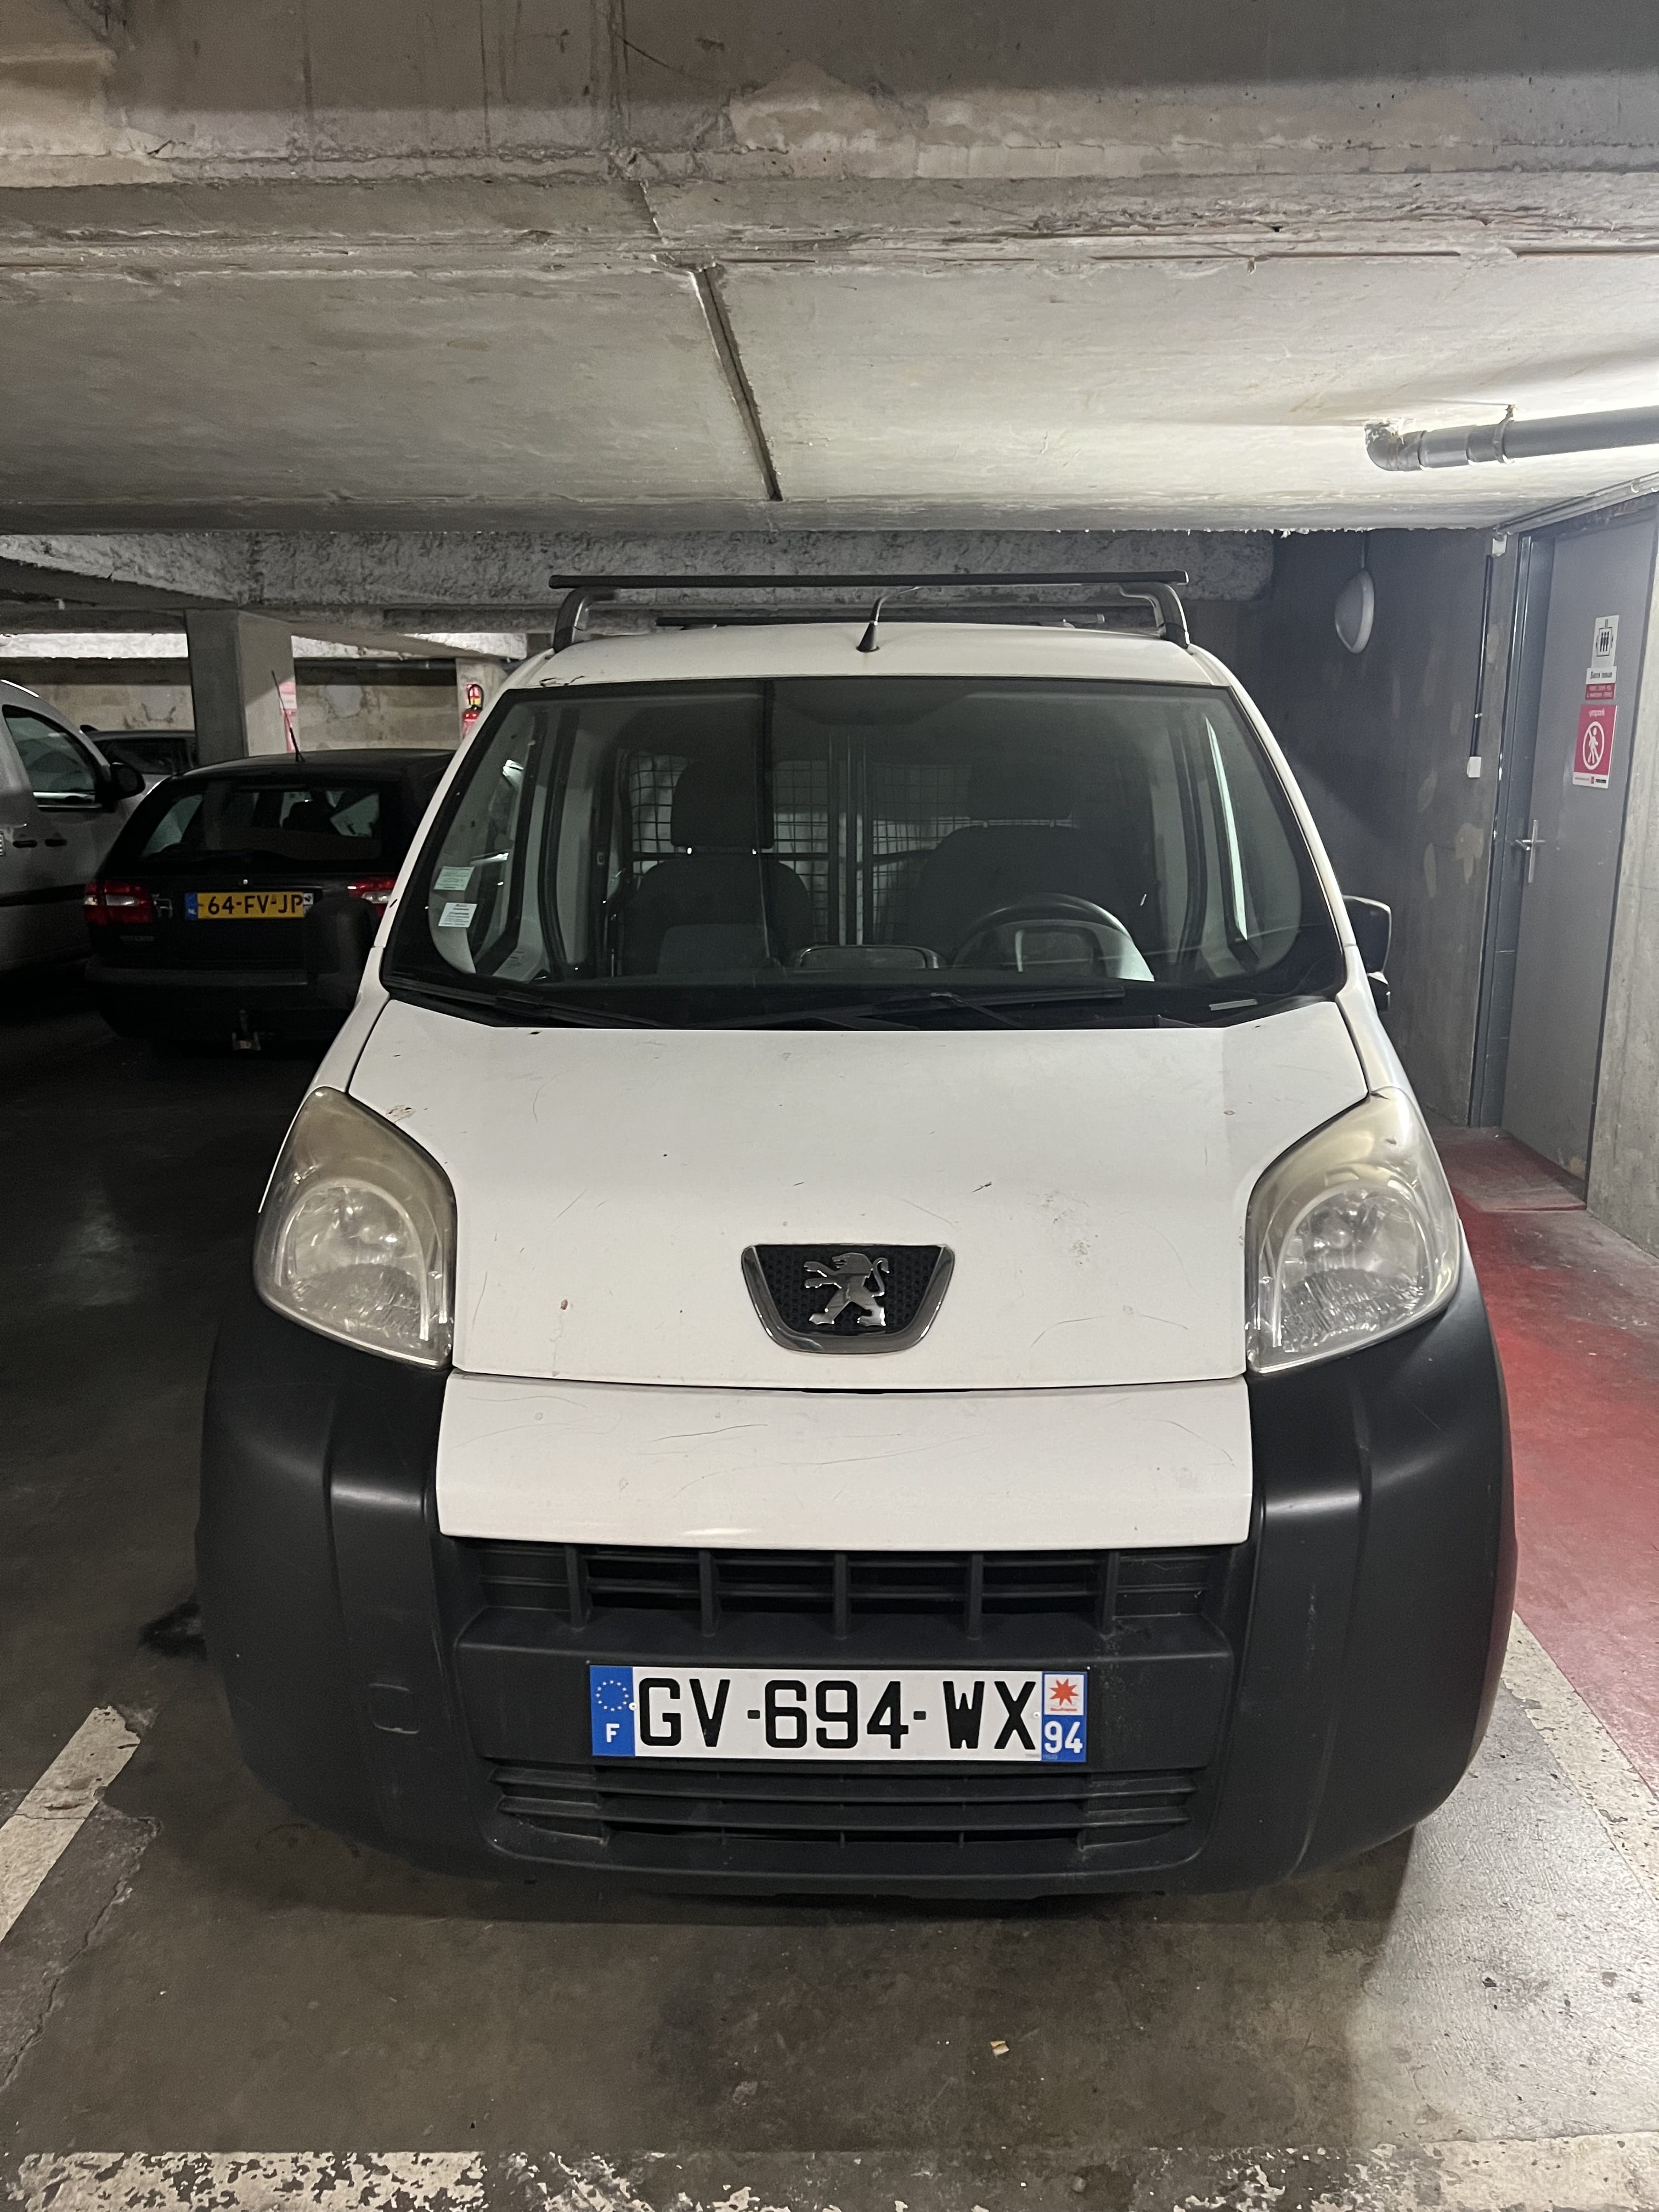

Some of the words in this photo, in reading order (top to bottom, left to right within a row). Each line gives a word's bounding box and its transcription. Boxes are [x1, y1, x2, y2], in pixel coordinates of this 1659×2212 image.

[207, 894, 303, 915] 64-FV-JP
[639, 1677, 1036, 1750] GV-694-WX
[606, 1723, 620, 1743] F
[1044, 1720, 1083, 1754] 94
